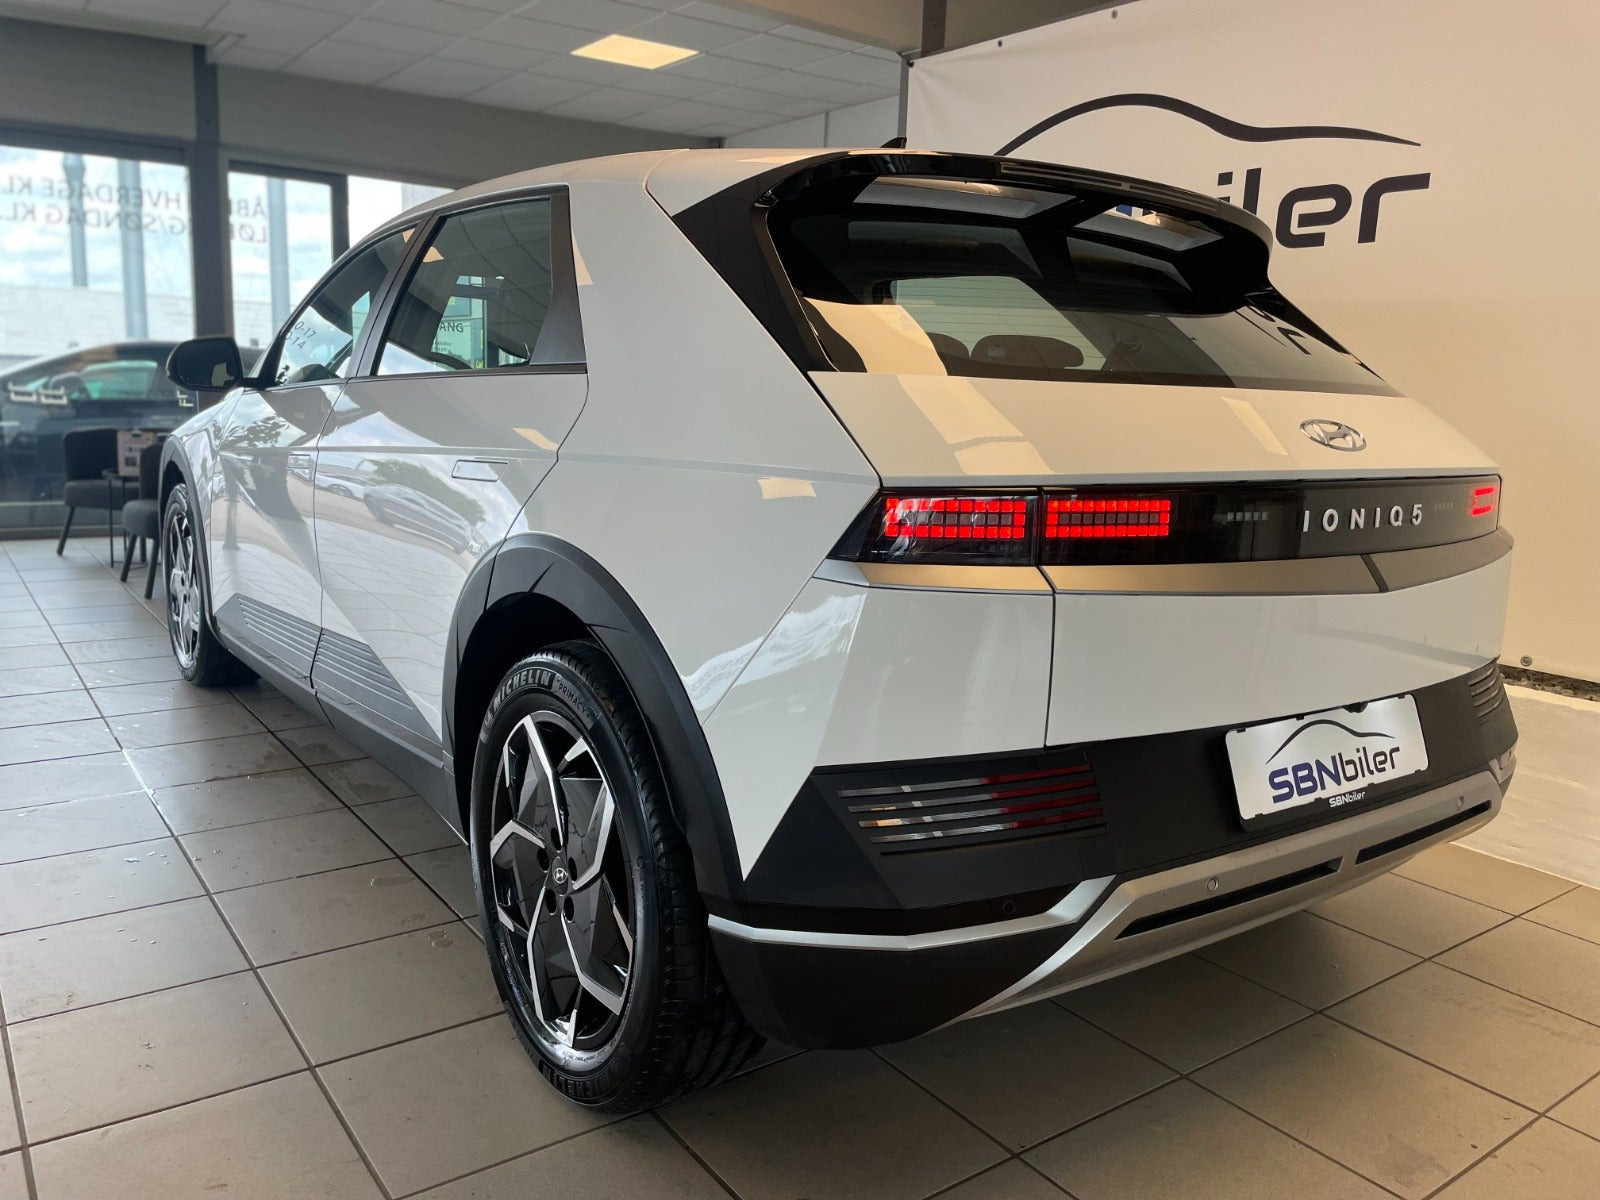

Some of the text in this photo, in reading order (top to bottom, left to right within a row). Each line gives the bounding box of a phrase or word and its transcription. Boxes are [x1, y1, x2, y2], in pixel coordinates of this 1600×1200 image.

[493, 669, 588, 714] MICHELIN PRIMACY
[1269, 746, 1400, 803] SBNbiler
[1329, 791, 1365, 808] SBNbiler
